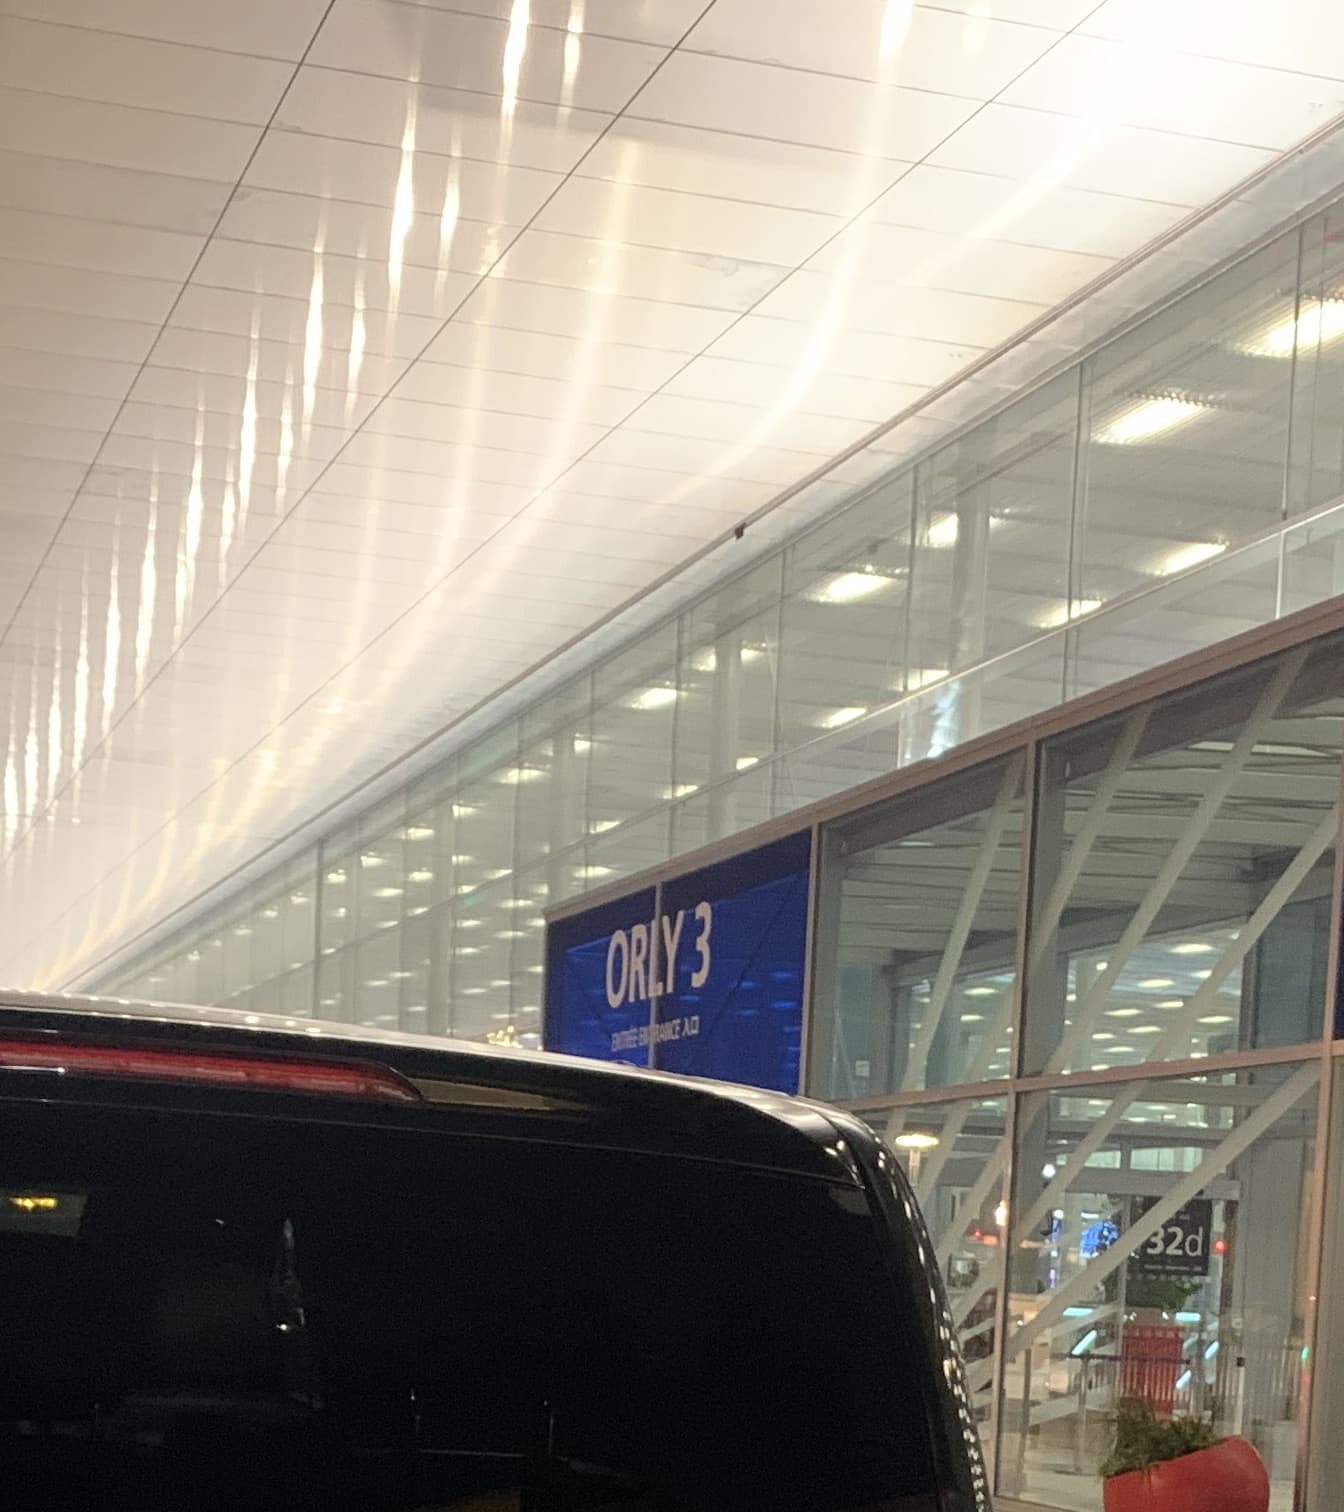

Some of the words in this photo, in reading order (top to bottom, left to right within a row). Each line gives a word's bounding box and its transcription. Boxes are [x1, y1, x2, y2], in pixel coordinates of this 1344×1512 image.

[606, 909, 685, 1008] ORLY
[691, 901, 712, 988] 3
[1145, 1225, 1204, 1257] 32d
